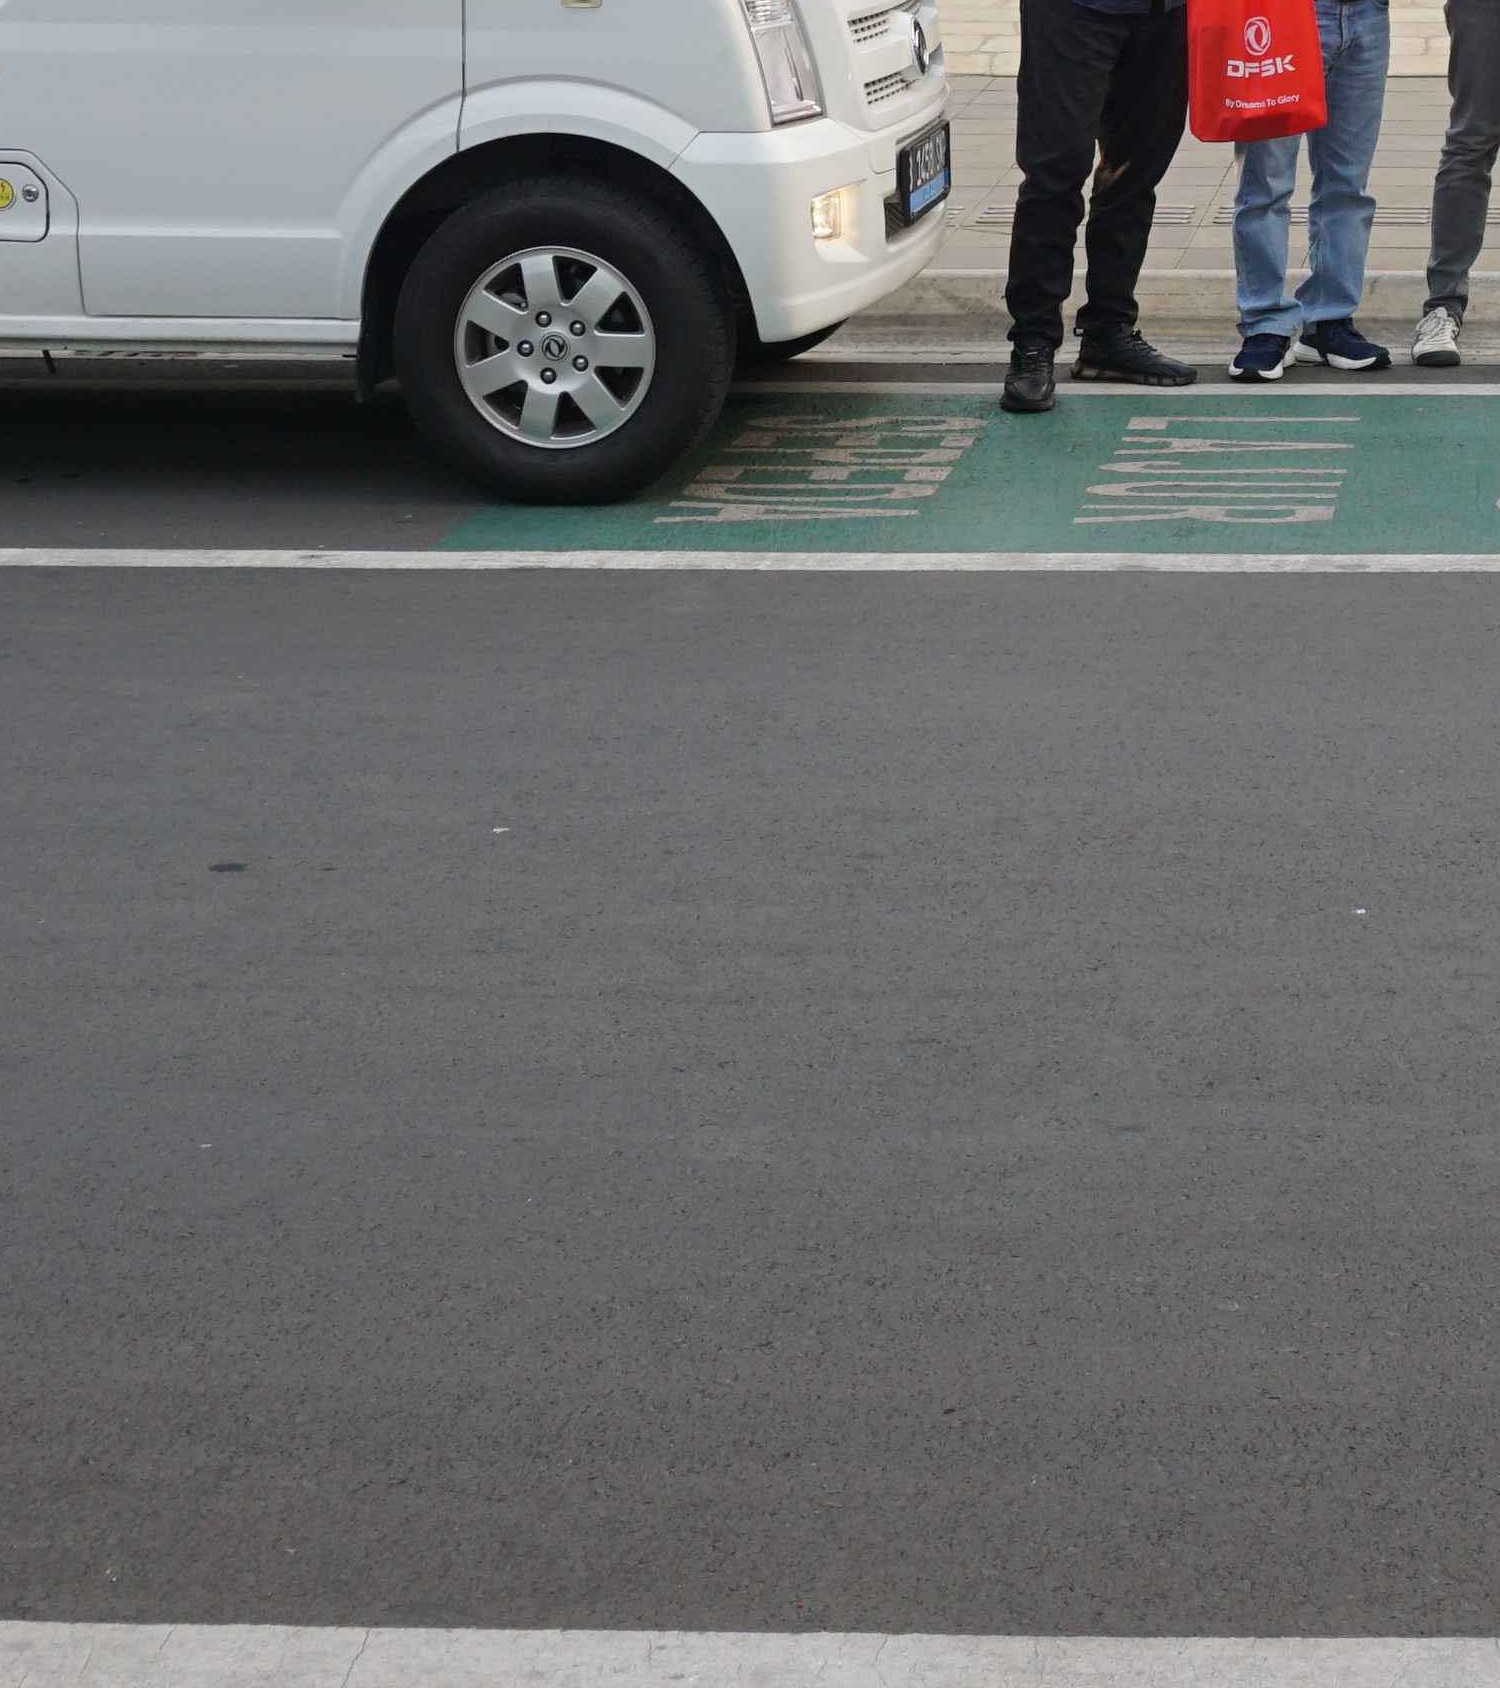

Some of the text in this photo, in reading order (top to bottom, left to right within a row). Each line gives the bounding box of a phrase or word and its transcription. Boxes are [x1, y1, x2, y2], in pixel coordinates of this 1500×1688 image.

[1226, 54, 1296, 78] DFSK
[1266, 97, 1277, 107] To
[1277, 94, 1300, 105] Glory
[653, 413, 993, 523] SEPEDA
[1073, 416, 1362, 524] LAJUR
